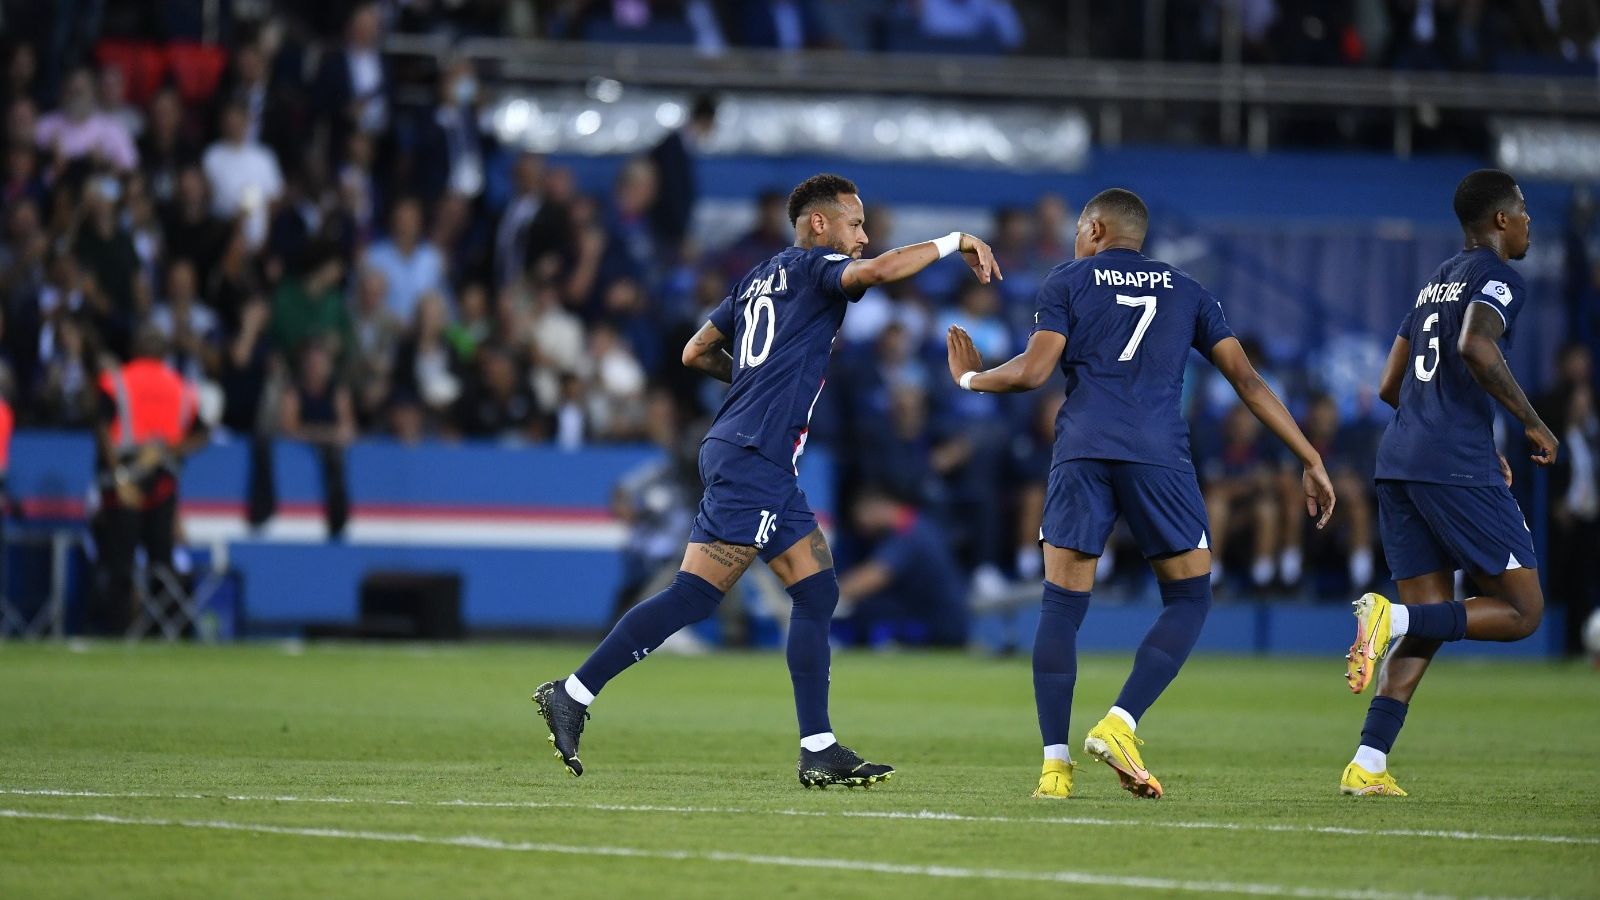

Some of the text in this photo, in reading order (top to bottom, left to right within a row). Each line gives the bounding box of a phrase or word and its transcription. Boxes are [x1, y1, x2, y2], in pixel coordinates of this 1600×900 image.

[740, 296, 775, 369] 10
[1115, 294, 1157, 362] 7
[1414, 312, 1440, 382] 3
[709, 552, 734, 568] VENCER
